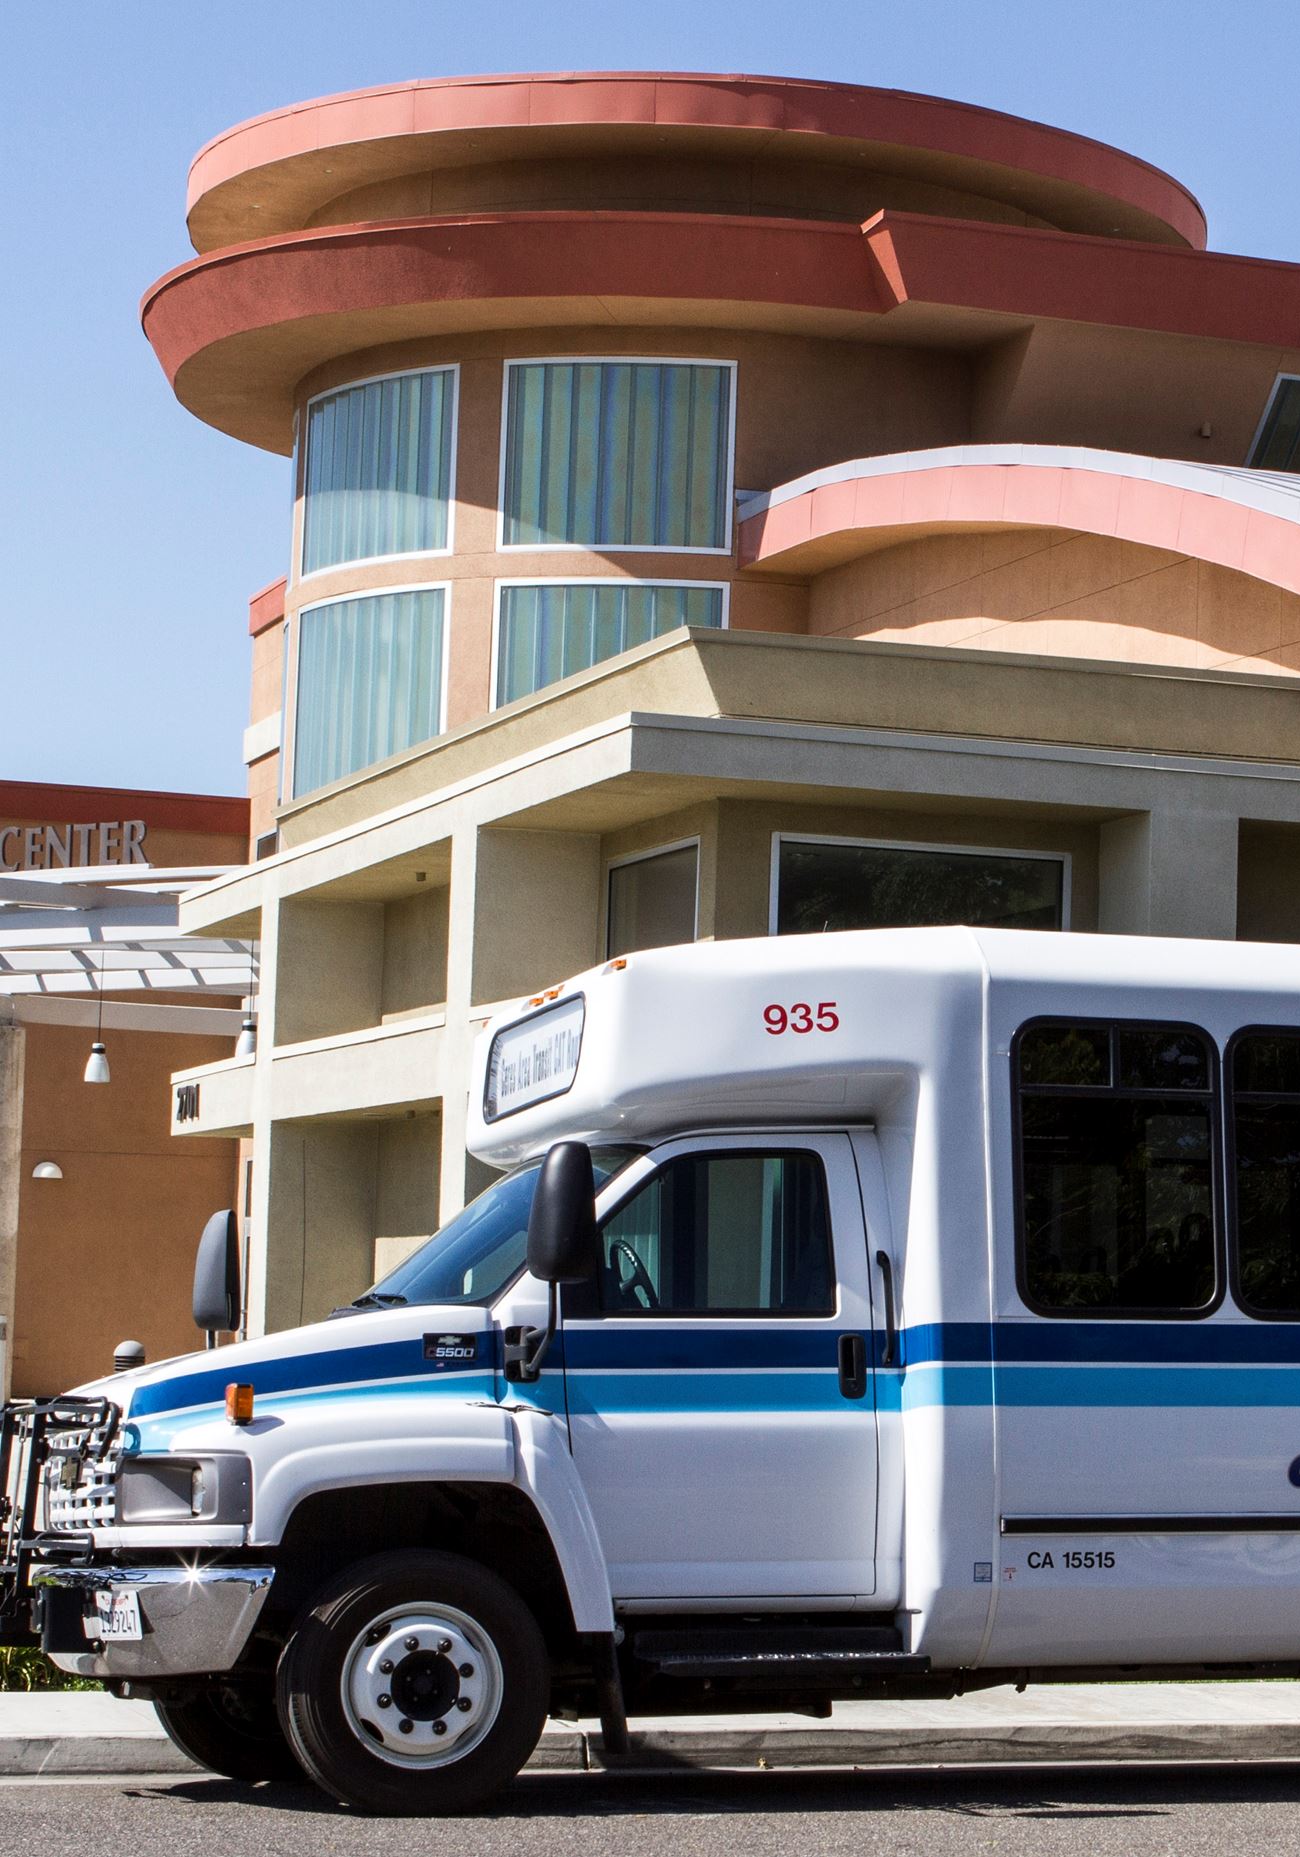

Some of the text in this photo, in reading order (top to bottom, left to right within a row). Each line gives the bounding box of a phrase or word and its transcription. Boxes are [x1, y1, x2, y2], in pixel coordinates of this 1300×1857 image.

[0, 820, 147, 872] CENTER
[763, 1002, 840, 1035] 935
[1027, 1552, 1116, 1569] CA 15515
